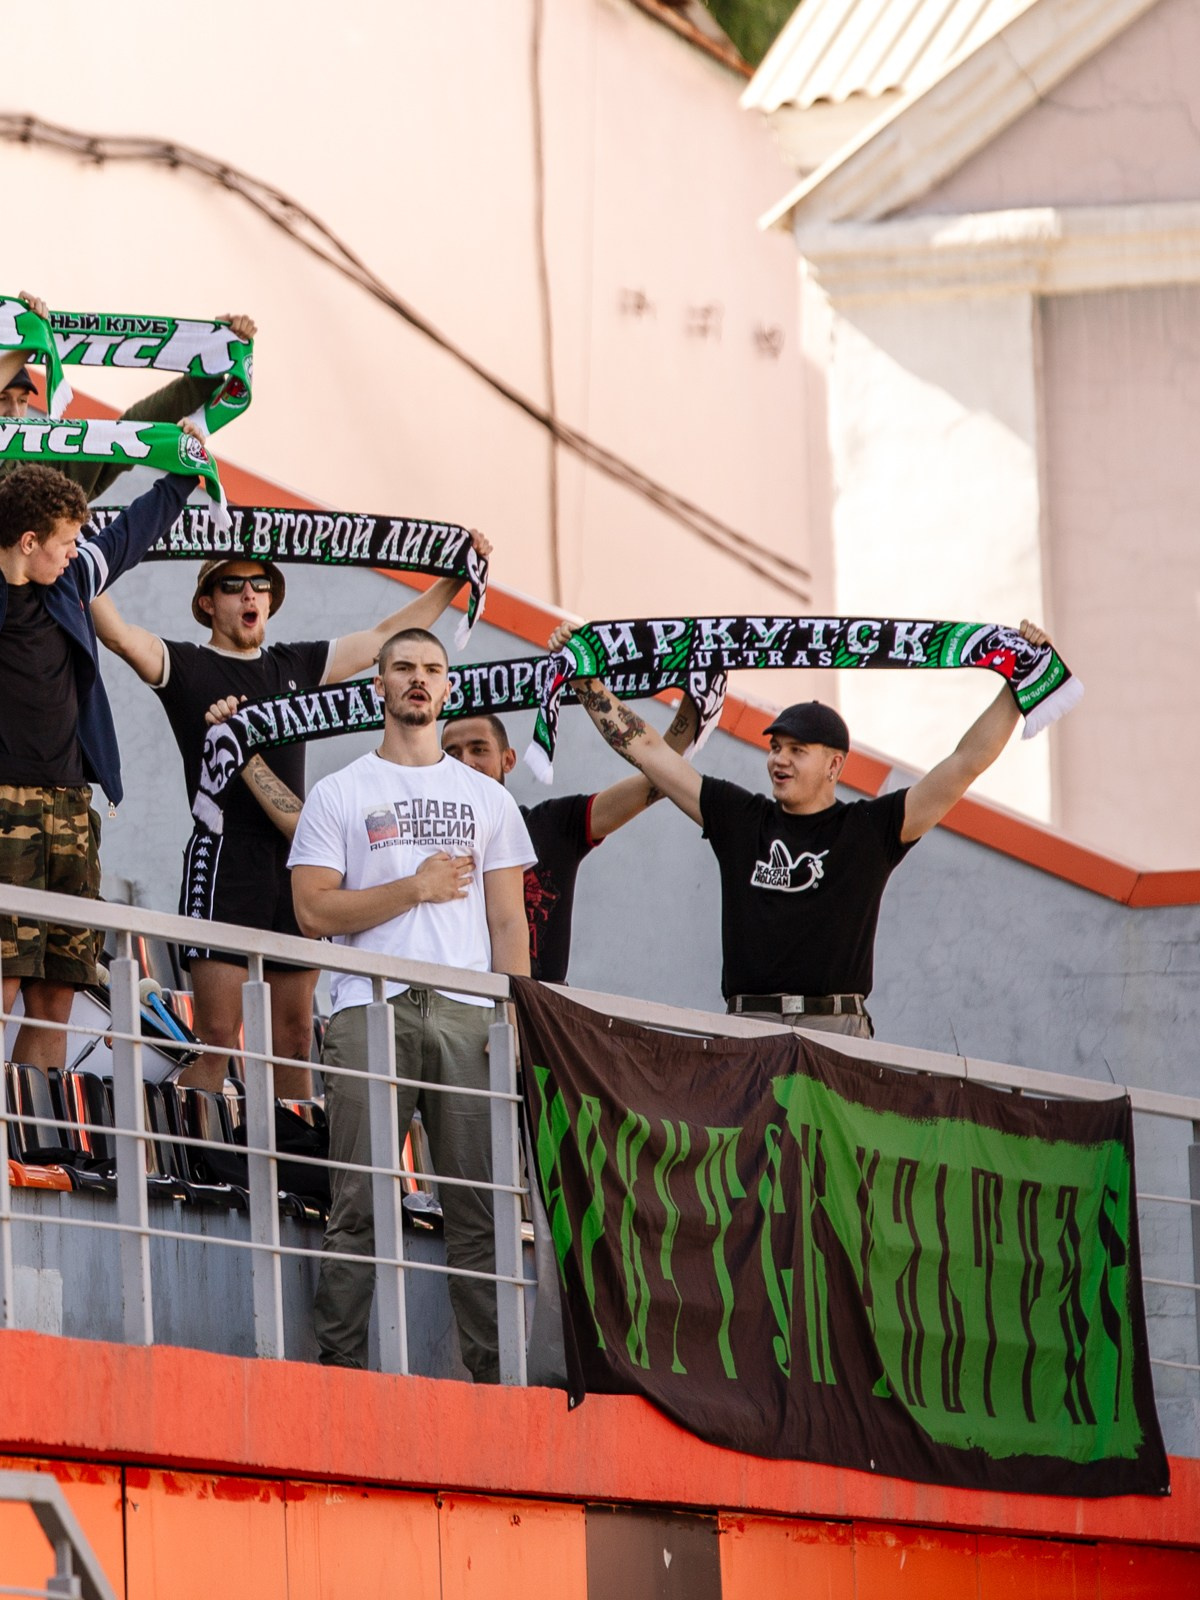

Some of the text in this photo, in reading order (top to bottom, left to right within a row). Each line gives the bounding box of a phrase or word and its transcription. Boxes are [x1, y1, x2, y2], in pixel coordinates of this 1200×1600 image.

[105, 316, 169, 334] КЛУБ
[252, 510, 377, 559] ВТОРОЙ
[376, 519, 470, 570] ЛИГИ
[592, 617, 934, 665] ИРКУТСК
[694, 649, 832, 669] ULTRAS
[393, 798, 475, 821] СЛАВА
